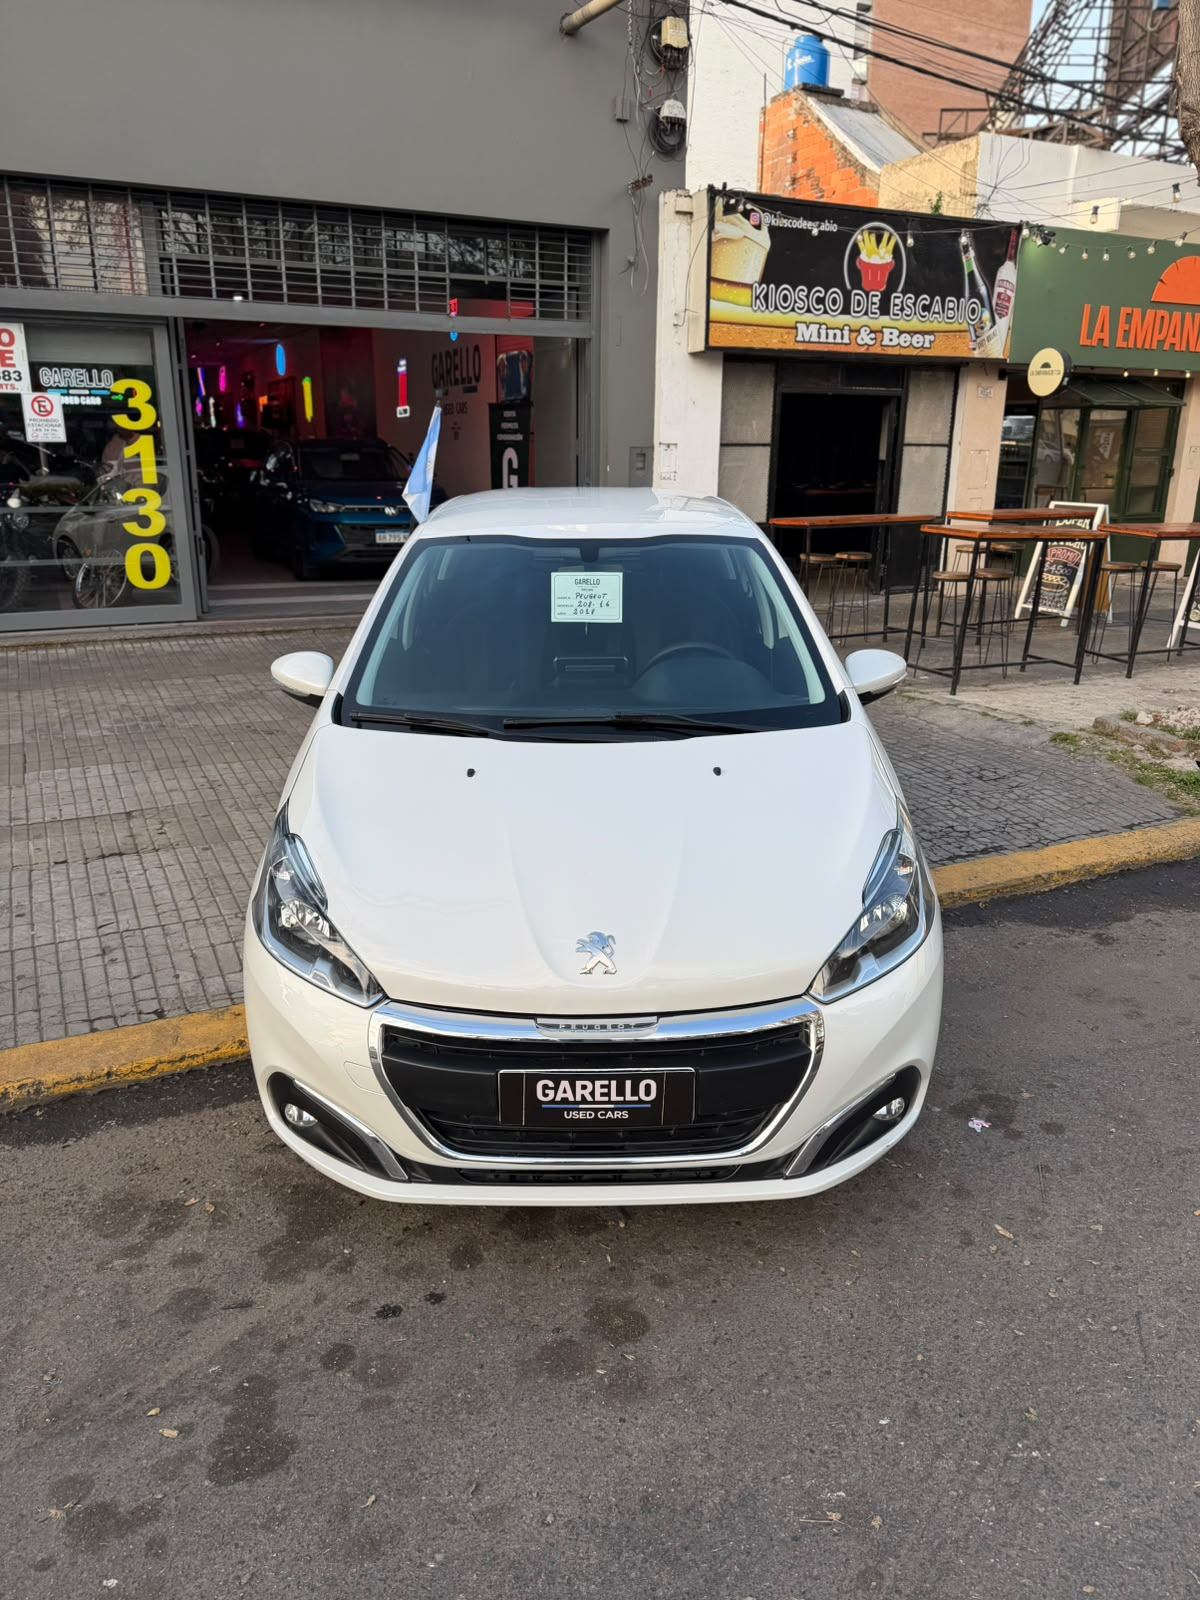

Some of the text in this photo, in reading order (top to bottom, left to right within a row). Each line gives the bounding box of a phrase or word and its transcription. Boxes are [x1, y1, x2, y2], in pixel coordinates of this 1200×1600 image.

[752, 283, 844, 317] KIOSCO
[850, 289, 881, 318] DE
[889, 293, 982, 325] ESCABIO
[795, 322, 936, 349] Mini & Beer
[1079, 303, 1200, 353] LA EMPAN
[0, 370, 23, 382] 83
[39, 367, 114, 388] GARELLO
[432, 344, 481, 389] GARELLO
[502, 447, 519, 488] G
[574, 578, 601, 586] GARELLO
[575, 592, 608, 600] PEUGEOT
[536, 1079, 657, 1102] GARELLO
[563, 1110, 629, 1120] USED CARS
